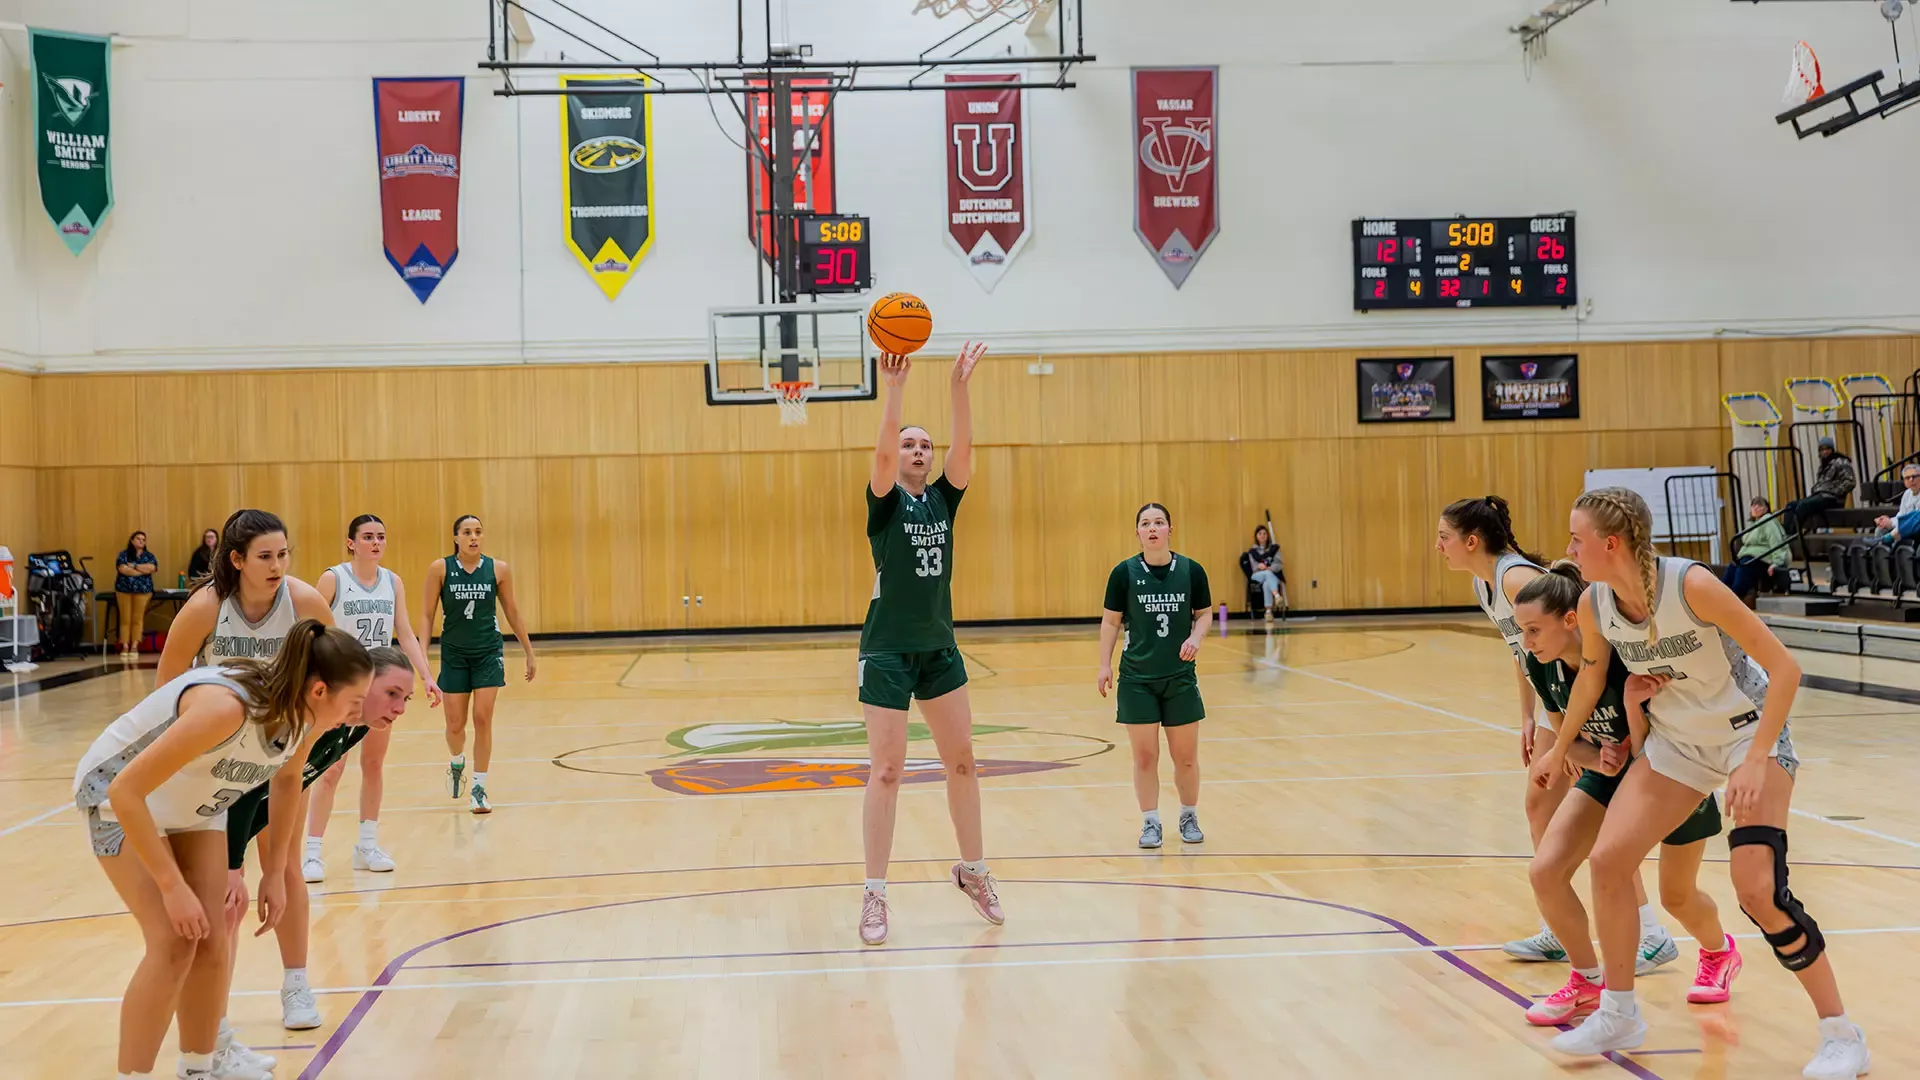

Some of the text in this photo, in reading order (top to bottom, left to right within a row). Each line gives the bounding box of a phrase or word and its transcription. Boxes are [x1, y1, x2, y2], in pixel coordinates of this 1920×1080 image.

[968, 102, 999, 114] UNION
[1156, 99, 1193, 111] VASSAR
[398, 110, 441, 122] LIBERTY
[581, 107, 632, 120] SKIDMORE
[46, 130, 106, 148] WILLIAM
[54, 145, 96, 161] SMITH
[386, 154, 457, 167] LIBERTY LEAGUE
[953, 123, 1015, 192] U
[959, 198, 1012, 211] DUTCHMEN
[1153, 196, 1200, 208] BREWERS
[402, 209, 442, 221] LEAGUE
[571, 205, 649, 218] THOROUGHBREDS
[952, 211, 1020, 224] DUTCHWOMEN
[820, 222, 862, 242] 5:08
[1363, 221, 1397, 236] HOME
[1530, 218, 1566, 232] GUEST
[1448, 222, 1494, 247] 5:08
[1377, 239, 1397, 262] 12
[1536, 236, 1565, 260] 26
[815, 248, 857, 285] 30
[1435, 253, 1471, 271] PERIOD 2
[1543, 264, 1568, 275] FOULS
[1362, 267, 1387, 278] FOULS
[1435, 268, 1459, 277] PLAYER
[1474, 267, 1491, 276] FOUL
[1374, 281, 1386, 298] 2
[1409, 280, 1421, 297] 4
[1439, 279, 1461, 297] 32
[1482, 280, 1489, 294] 1
[1511, 278, 1522, 294] 4
[1555, 277, 1567, 294] 2
[903, 520, 949, 536] WILLIAM
[911, 533, 946, 547] SMITH
[915, 547, 943, 577] 33
[449, 583, 491, 593] WILLIAM
[455, 592, 485, 600] SMITH
[1137, 593, 1186, 604] WILLIAM
[343, 599, 394, 616] SKIDMORE
[463, 600, 476, 620] 4
[1145, 603, 1179, 613] SMITH
[356, 618, 389, 647] 24
[1156, 613, 1169, 638] 3
[213, 635, 285, 658] SKIDMO
[1582, 721, 1615, 733] ITH
[210, 758, 281, 785] SKIDM
[195, 788, 243, 817] 3
